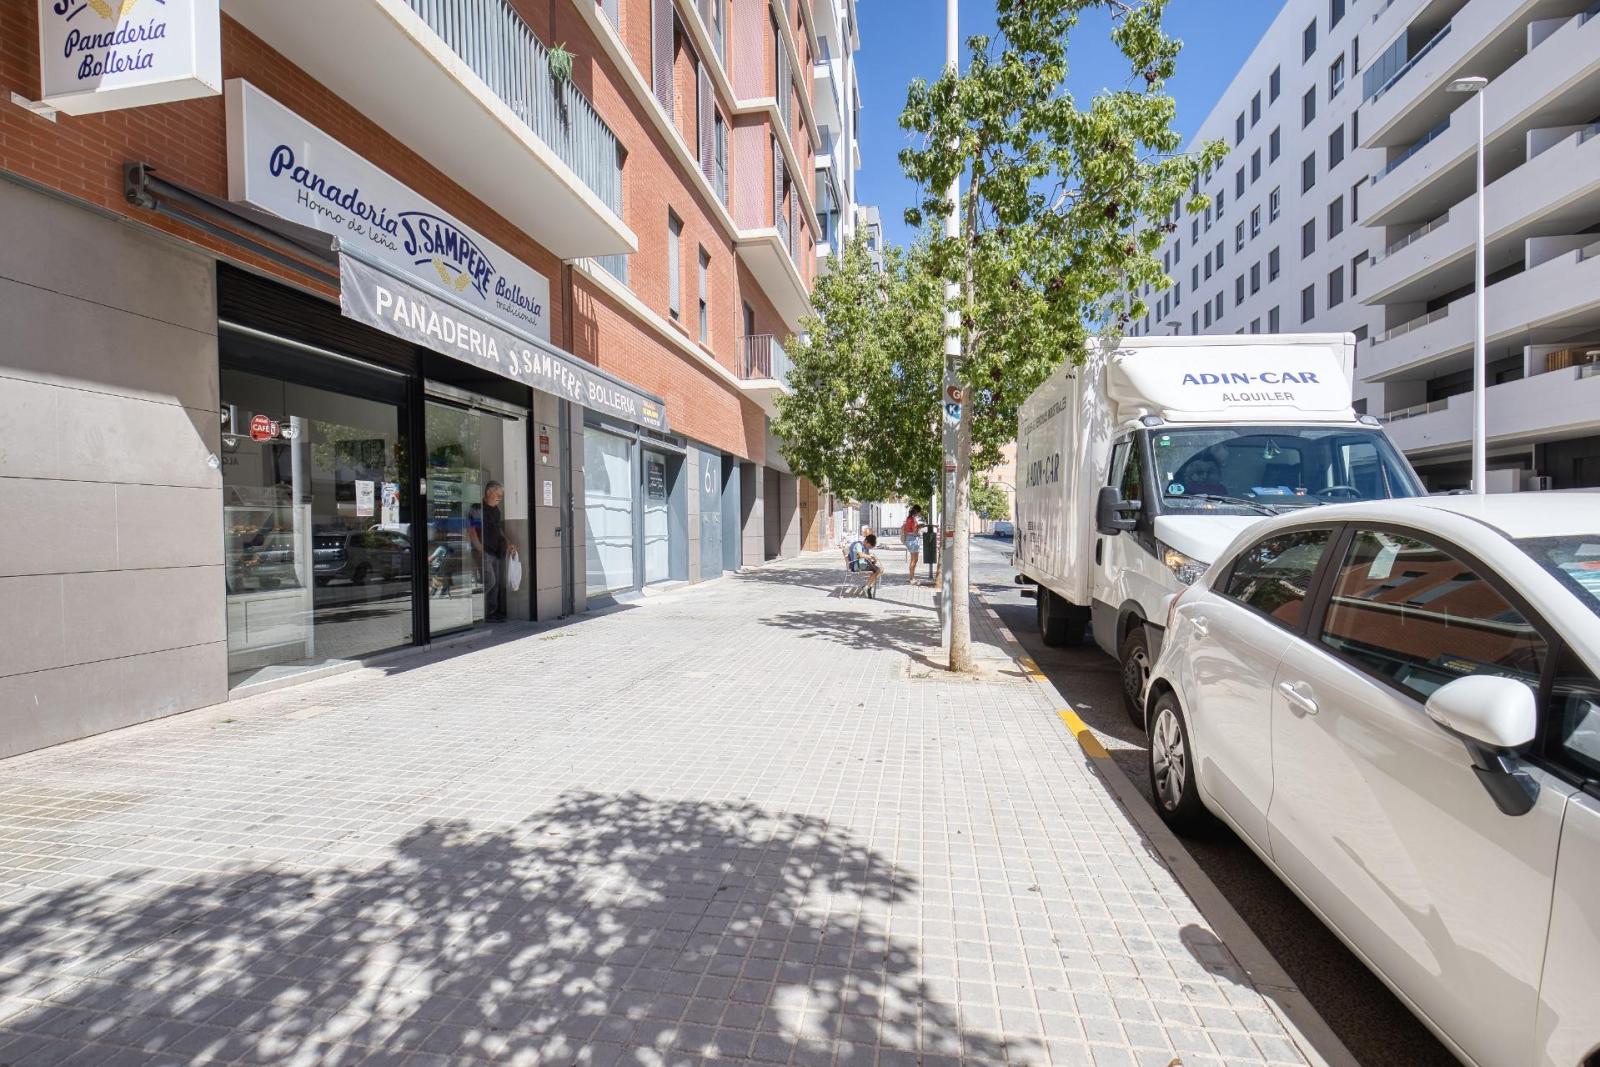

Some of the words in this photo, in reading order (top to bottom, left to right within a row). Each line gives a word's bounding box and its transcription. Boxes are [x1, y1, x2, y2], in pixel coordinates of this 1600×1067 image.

[64, 18, 166, 58] Panadería
[77, 49, 154, 80] Bollería
[269, 144, 398, 237] Panadería
[495, 275, 541, 317] Bollería
[297, 188, 346, 223] Horno
[347, 218, 366, 235] de
[368, 226, 398, 251] leña
[376, 285, 500, 363] PANADERIA
[588, 381, 637, 416] BOLLERIA
[1181, 371, 1321, 386] ADIN-CAR
[1221, 391, 1296, 402] ALQUILER
